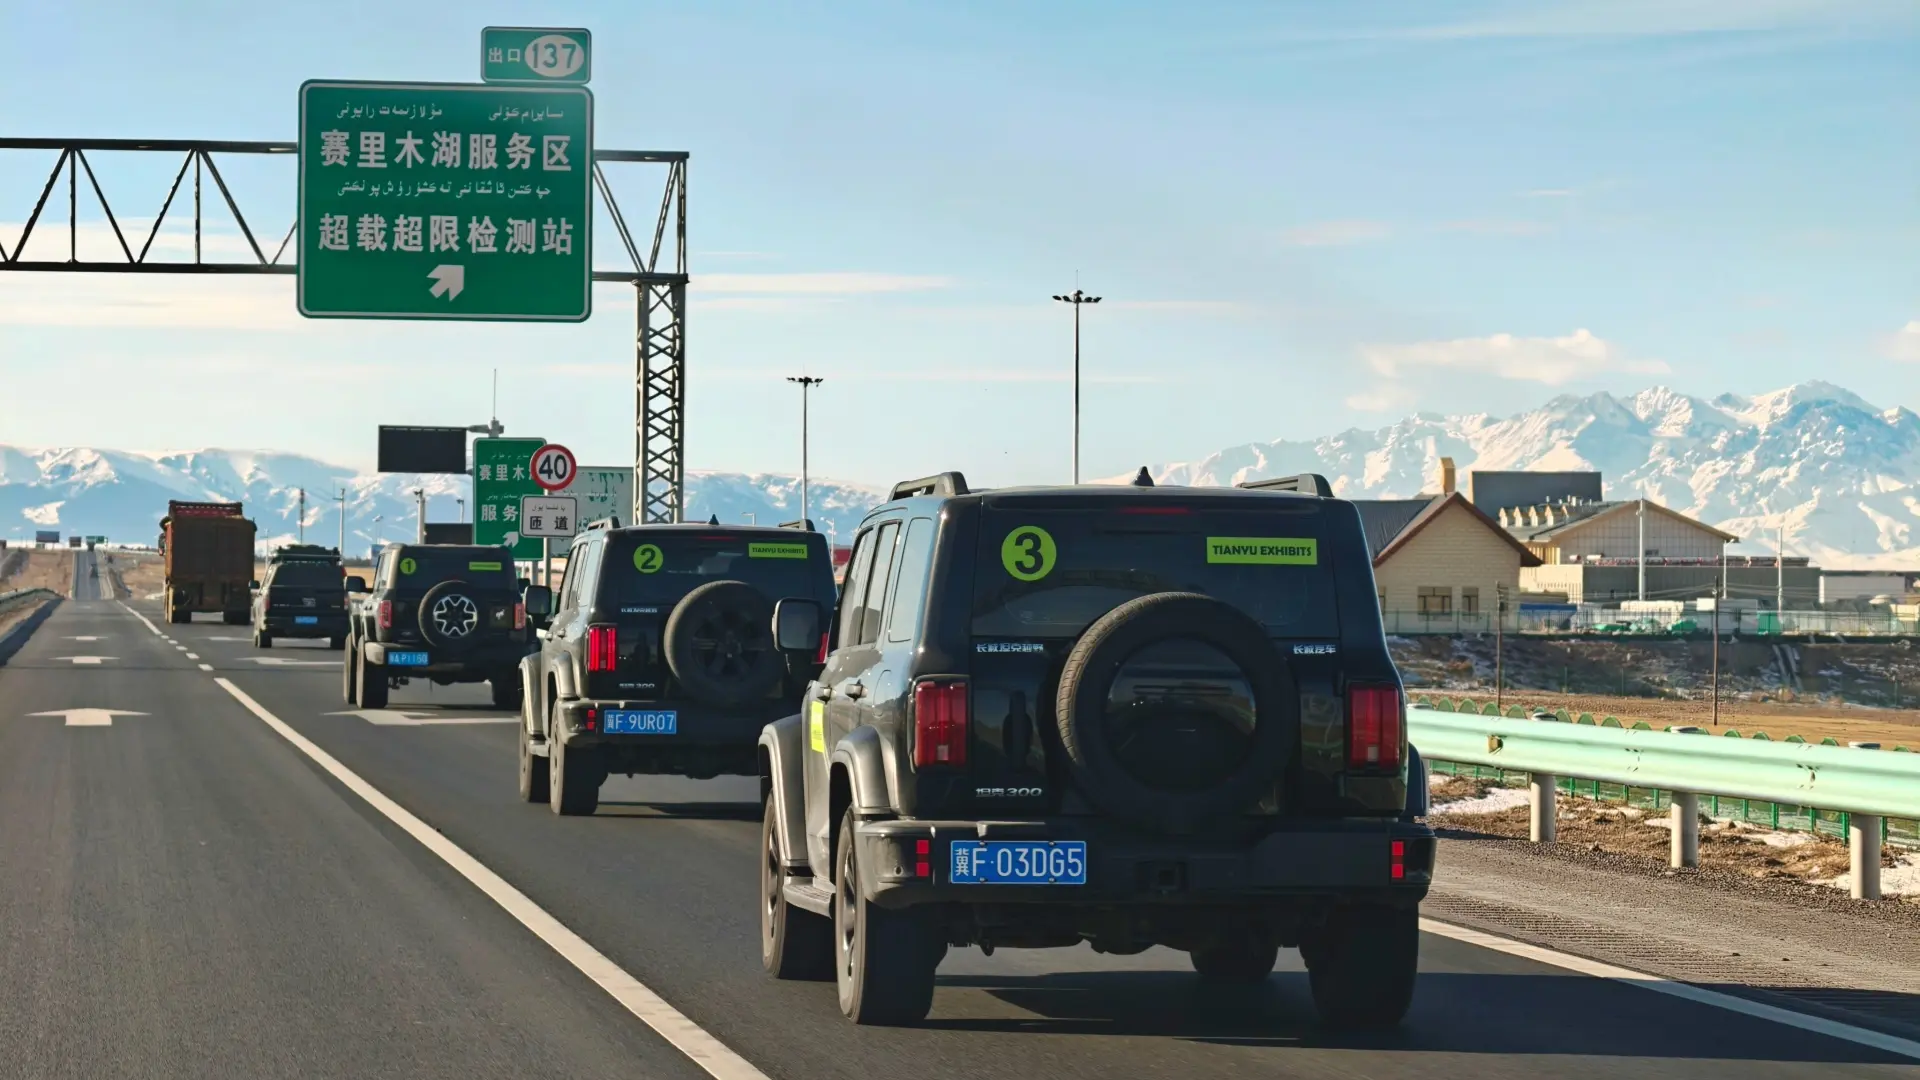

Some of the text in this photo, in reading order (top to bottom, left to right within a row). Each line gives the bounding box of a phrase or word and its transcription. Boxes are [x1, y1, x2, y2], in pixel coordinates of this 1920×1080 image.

[489, 43, 577, 68] 出口 137
[319, 129, 573, 172] 赛里木湖服务区
[317, 212, 574, 255] 超载超限检测站
[479, 464, 531, 481] 赛里木
[538, 454, 568, 480] 40
[529, 515, 569, 531] 匝道
[640, 547, 657, 570] 2
[1015, 532, 1044, 575] 3
[1212, 545, 1311, 556] TIANYU EXHIBITS
[405, 560, 412, 573] 1
[955, 847, 1083, 877] 冀F·03DG5
